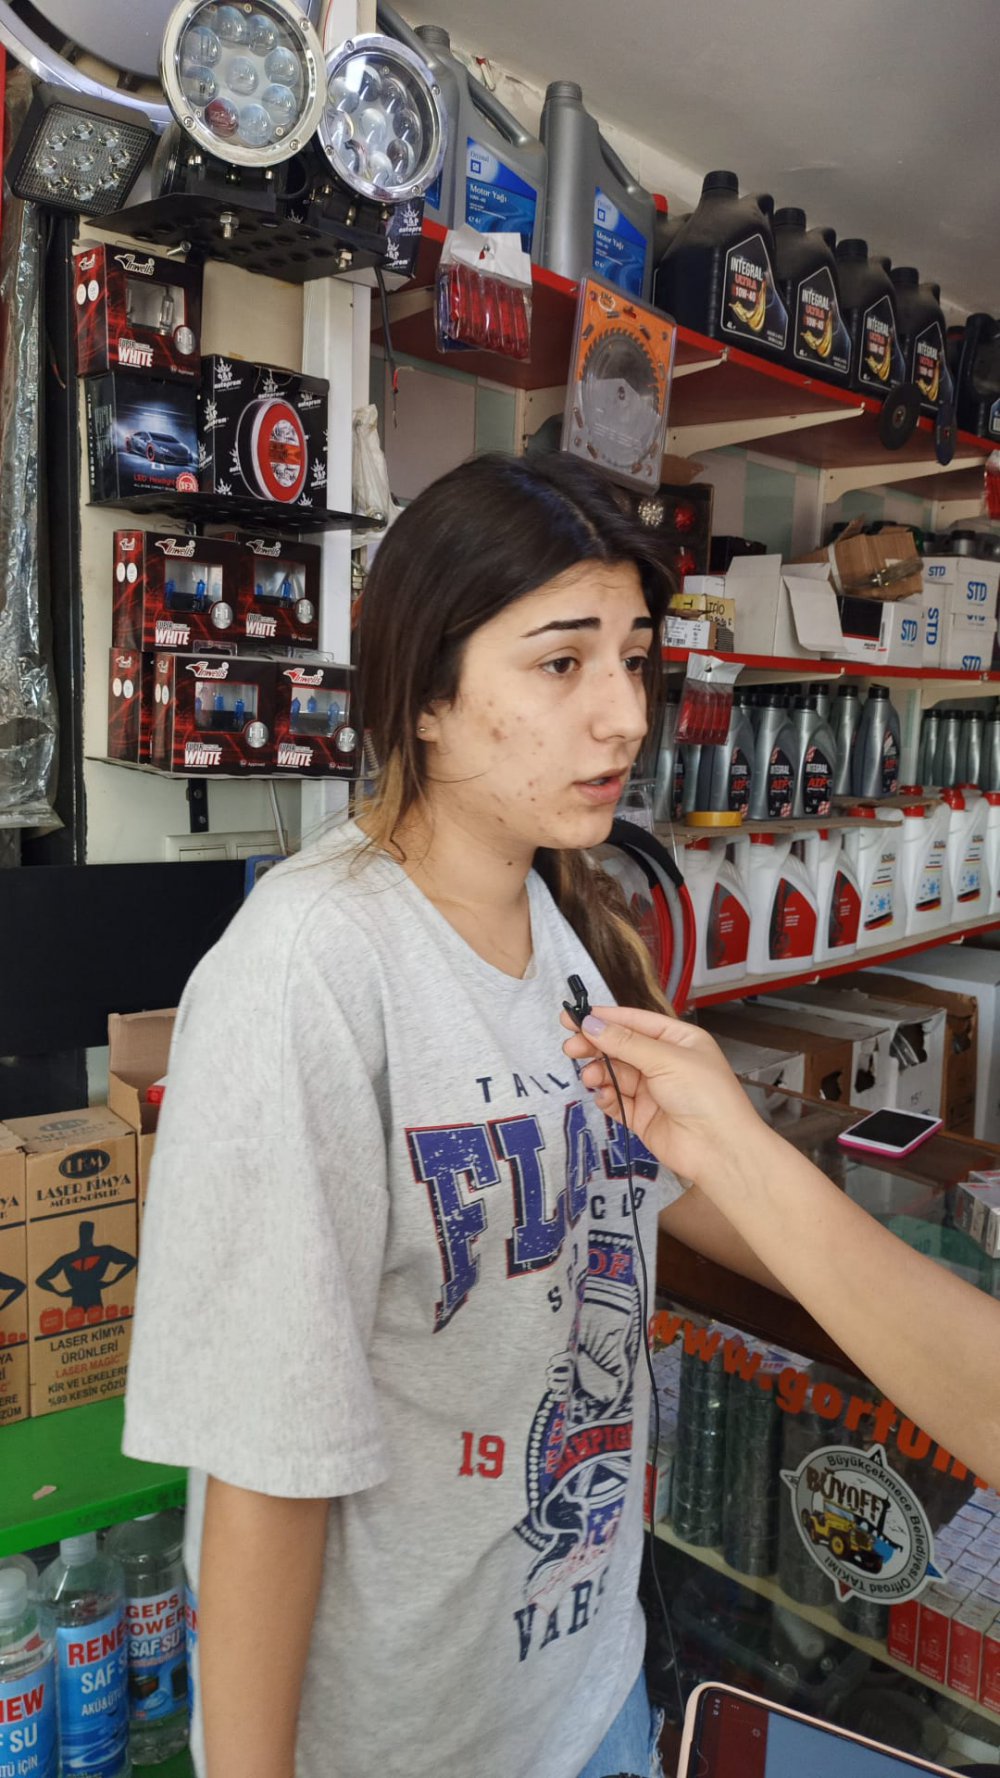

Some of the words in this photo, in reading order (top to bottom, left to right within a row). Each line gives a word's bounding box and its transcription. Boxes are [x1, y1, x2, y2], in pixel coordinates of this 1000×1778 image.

[118, 345, 154, 368] WHITE
[928, 565, 946, 577] STD
[967, 581, 987, 602] STD
[155, 628, 191, 646] WHITE
[246, 620, 277, 638] WHITE
[901, 619, 918, 642] STD
[926, 607, 939, 646] STD
[962, 655, 982, 671] STD
[184, 750, 222, 766] WHITE
[277, 750, 313, 767] WHITE
[37, 1182, 83, 1202] LASER
[50, 1335, 90, 1353] LASER
[91, 1323, 126, 1342] KİMYA
[61, 1339, 119, 1365] ÜRÜNLERİ
[55, 1362, 89, 1379] LASER
[67, 1377, 80, 1389] VE
[69, 1385, 98, 1402] KESİN
[458, 1430, 506, 1480] 19
[126, 1593, 179, 1619] GEPS
[129, 1639, 160, 1658] SAF
[162, 1630, 180, 1652] SU
[80, 1660, 115, 1695] SAF
[9, 1721, 38, 1754] SU
